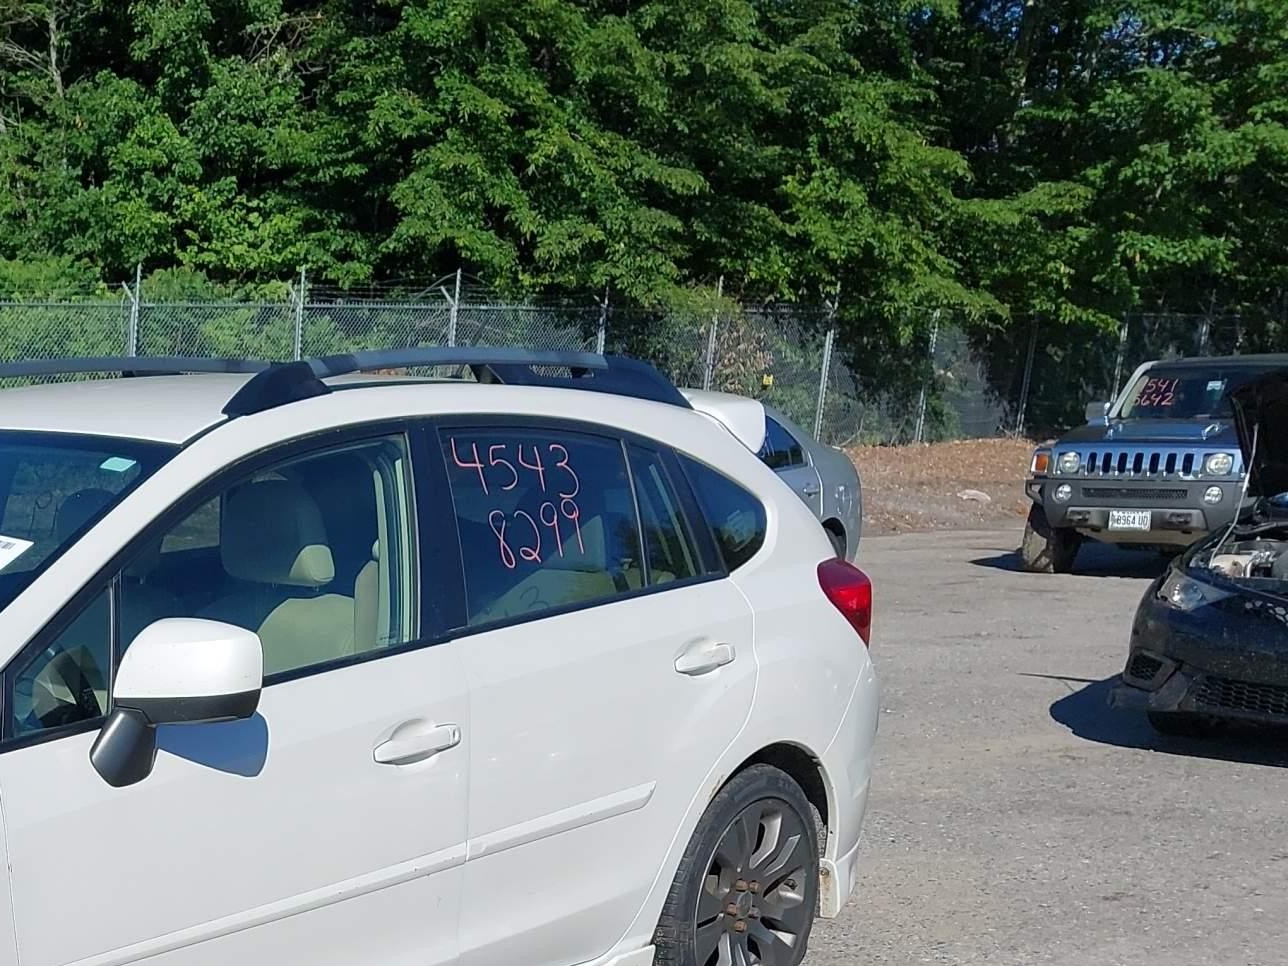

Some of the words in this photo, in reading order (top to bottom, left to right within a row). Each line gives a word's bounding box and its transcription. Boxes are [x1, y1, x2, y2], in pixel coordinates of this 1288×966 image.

[450, 436, 581, 499] 4543
[488, 498, 585, 569] 8299
[1116, 515, 1136, 525] 8964
